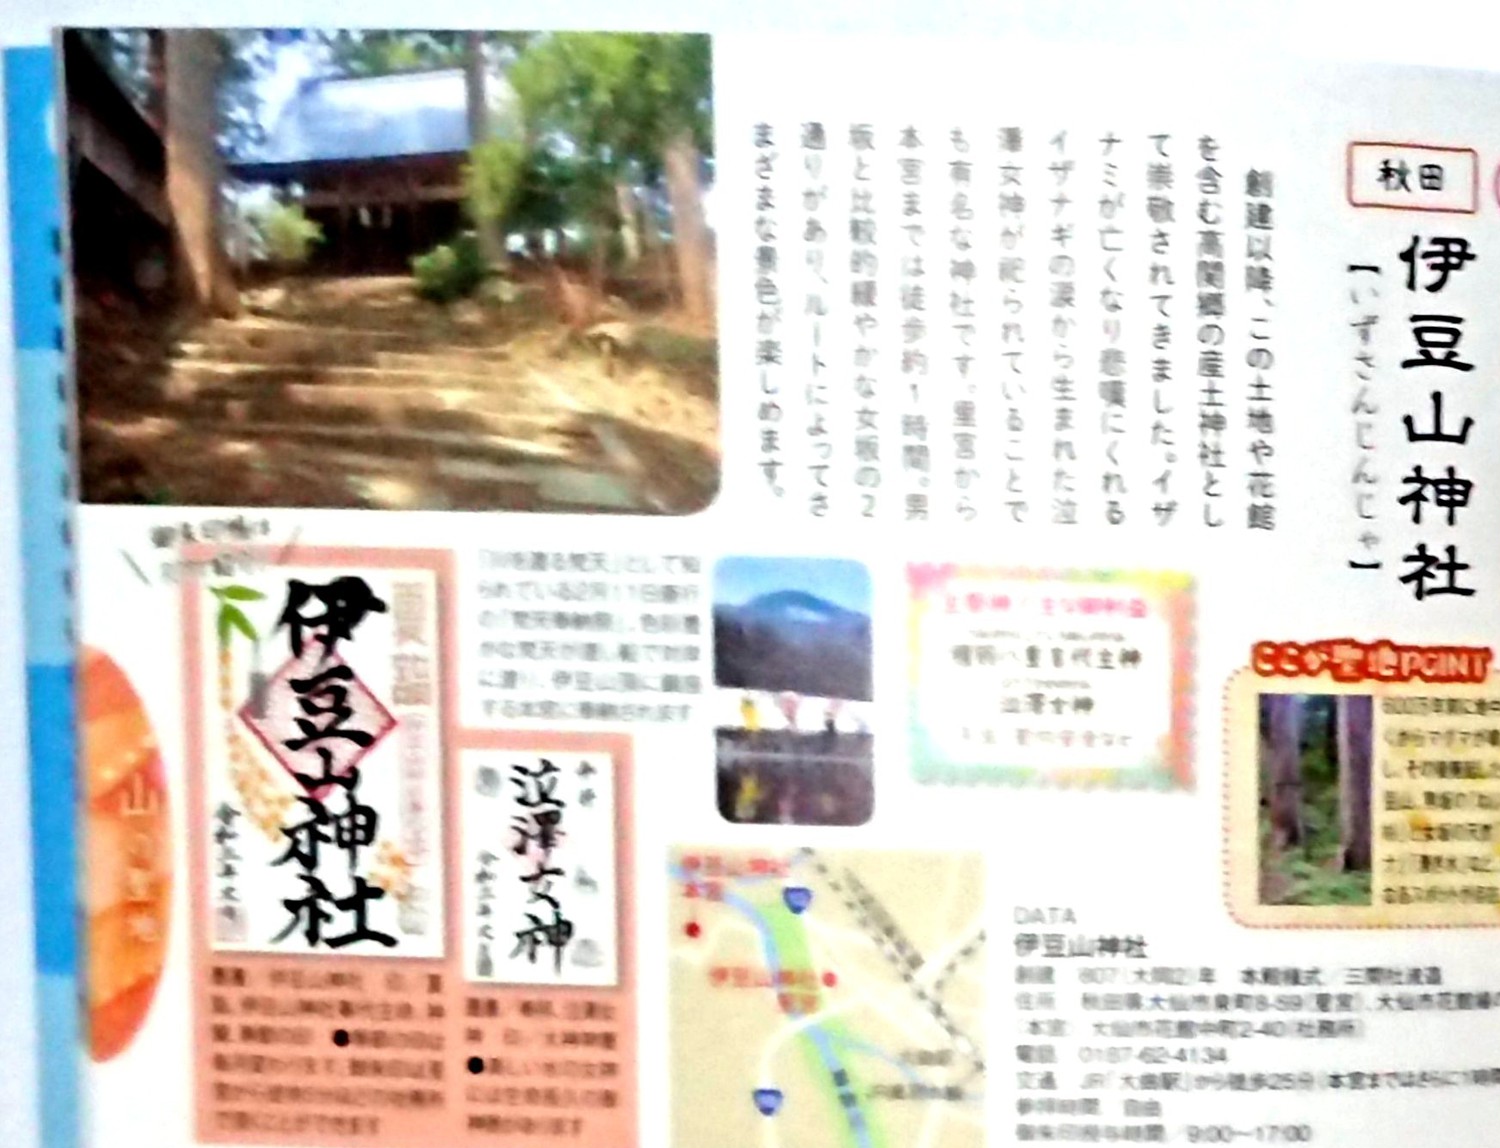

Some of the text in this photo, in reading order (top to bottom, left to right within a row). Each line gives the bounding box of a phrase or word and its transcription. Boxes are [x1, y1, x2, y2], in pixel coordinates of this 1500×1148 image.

[1376, 161, 1446, 194] 秋田
[1399, 232, 1478, 603] 伊豆山神社
[272, 577, 398, 947] 伊豆山神社
[1013, 906, 1077, 926] DATA
[1014, 933, 1149, 959] 伊豆山神社
